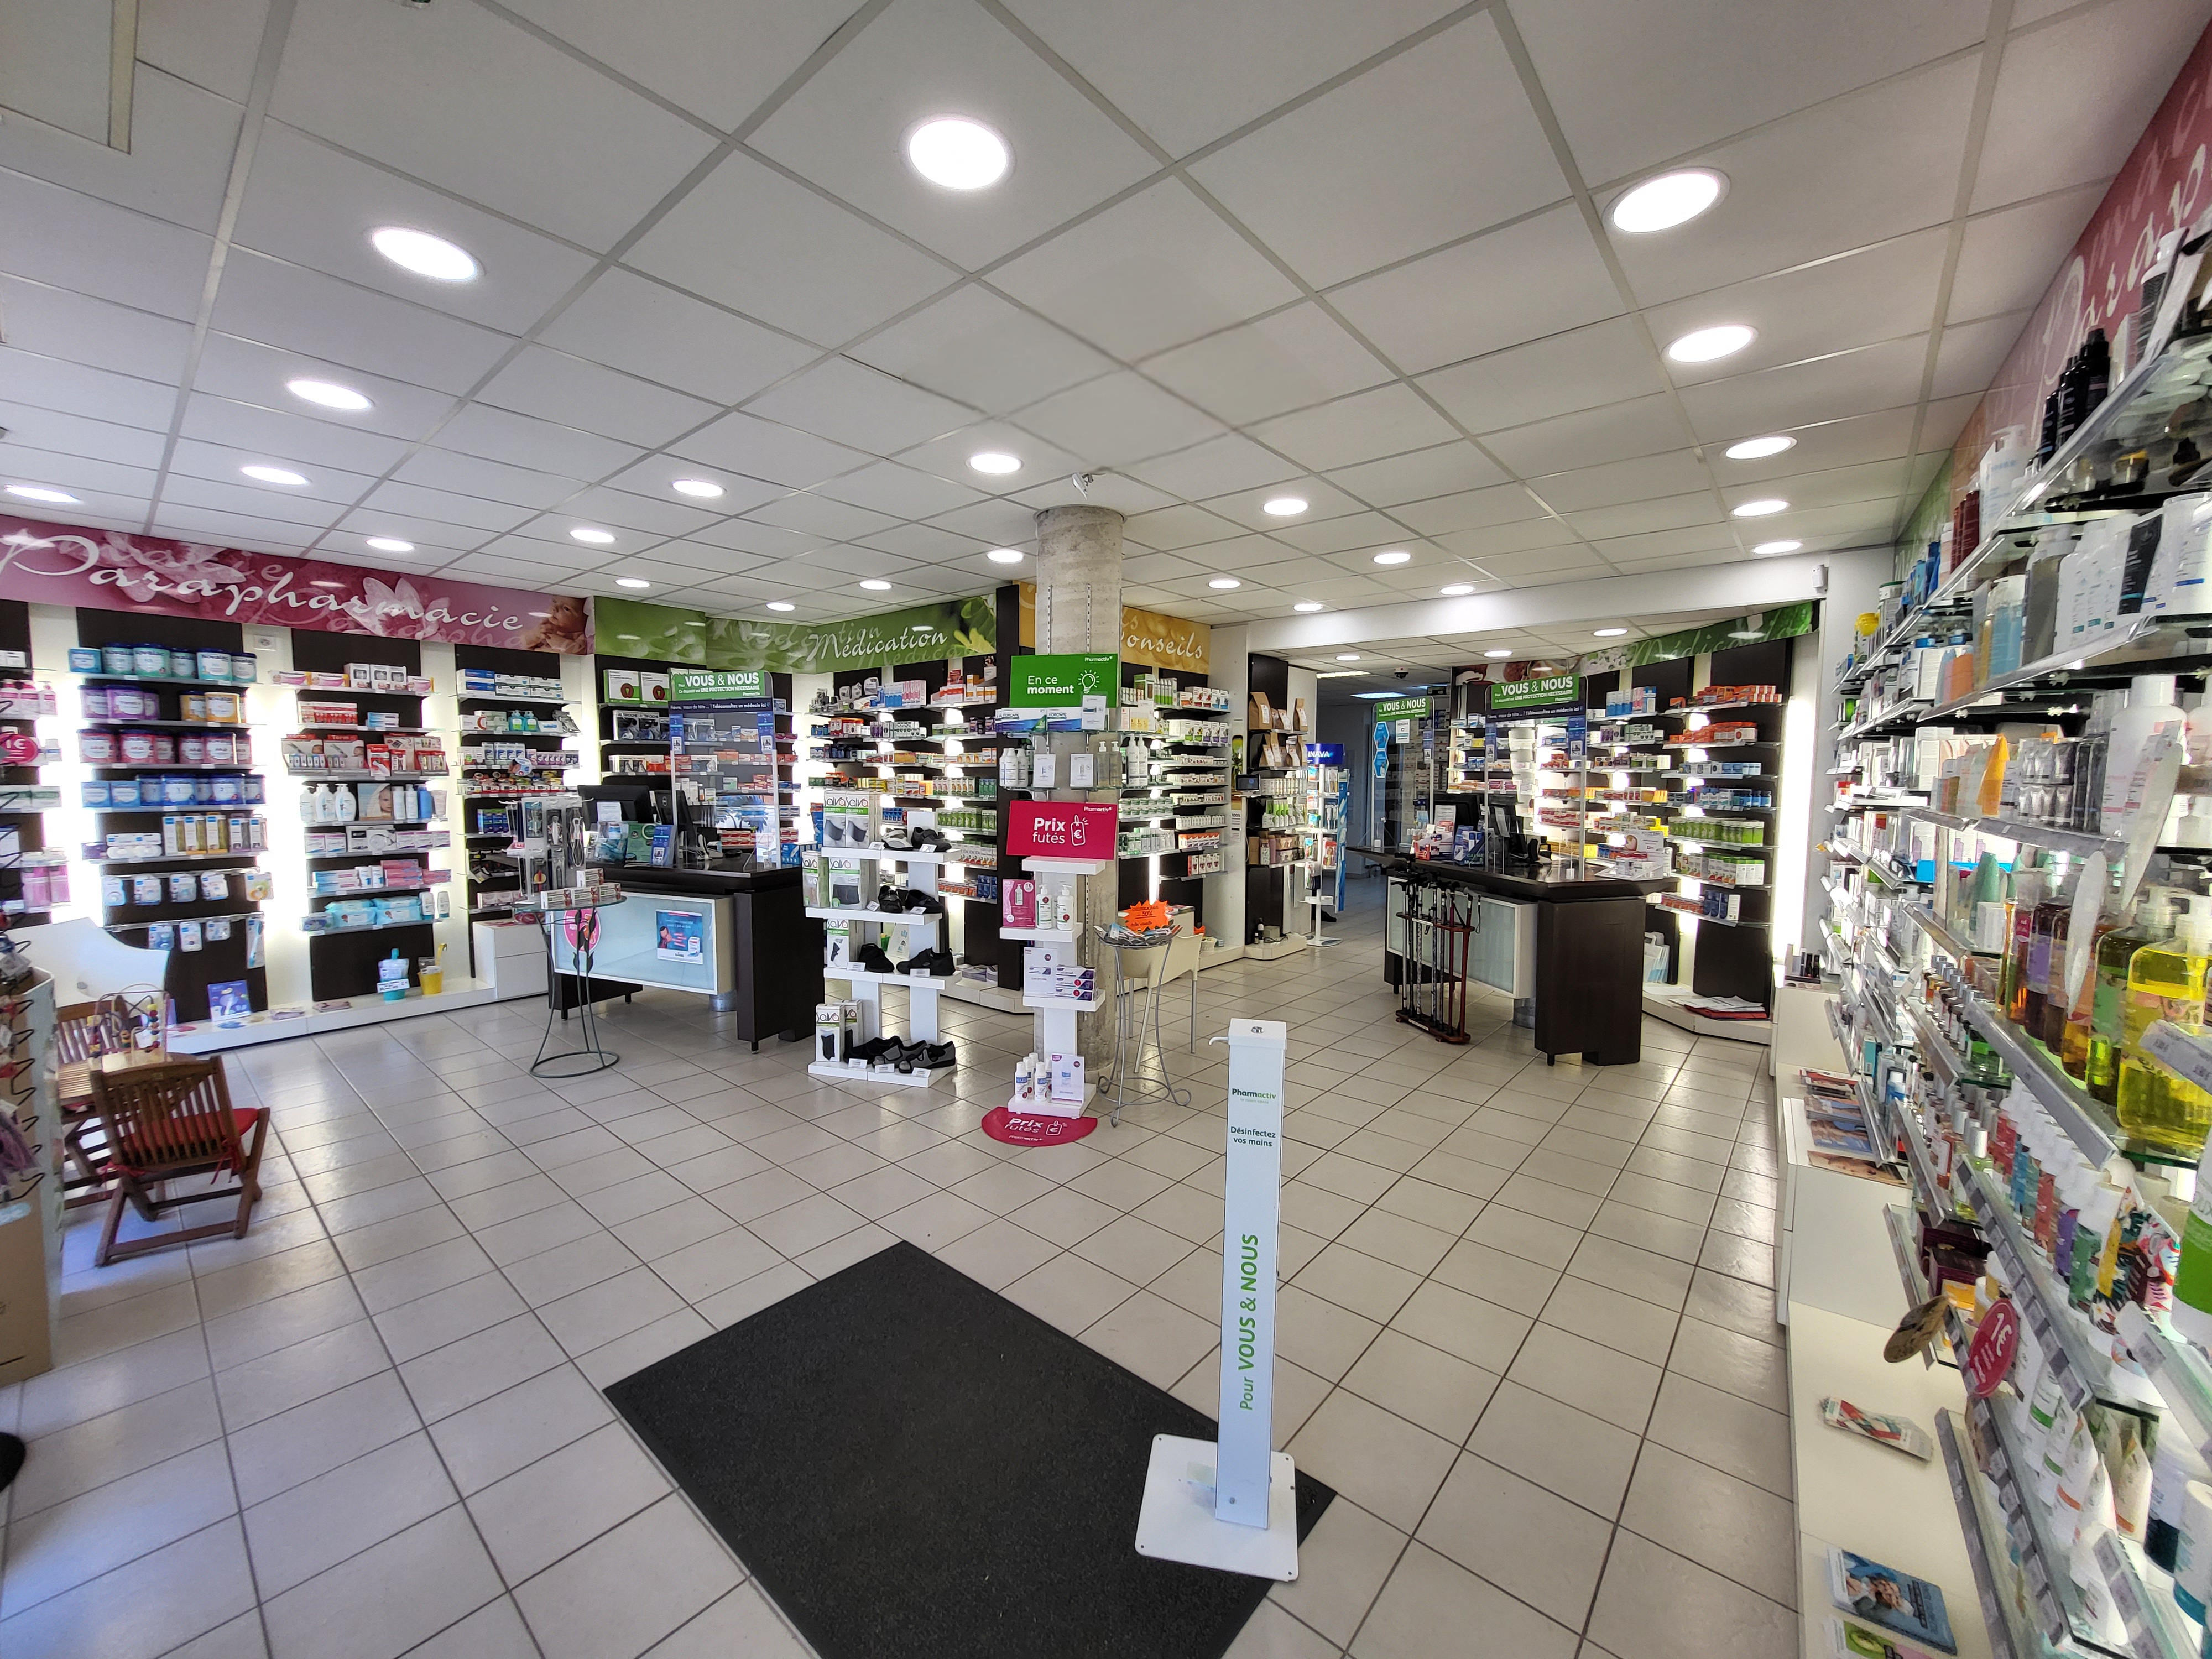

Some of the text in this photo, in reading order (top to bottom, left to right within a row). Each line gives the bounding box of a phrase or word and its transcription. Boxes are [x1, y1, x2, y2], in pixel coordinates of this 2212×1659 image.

[0, 534, 523, 631] Parapharmacie
[806, 626, 948, 662] Médication
[1121, 632, 1203, 660] onseils
[685, 675, 715, 687] VOUS
[717, 674, 725, 686] &
[727, 672, 759, 685] NOUS
[1027, 675, 1058, 685] En ce
[1501, 682, 1529, 696] VOUS
[1531, 681, 1538, 692] &
[1541, 676, 1573, 691] NOUS
[1027, 685, 1074, 695] moment
[1383, 701, 1400, 712] VOUS
[1401, 701, 1406, 710] &
[1406, 698, 1426, 709] NOUS
[1034, 817, 1066, 832] Prix
[1032, 831, 1065, 844] futés
[844, 1009, 857, 1018] lva
[1232, 1088, 1277, 1100] Pharmactiv
[1004, 1123, 1039, 1133] futés
[1009, 1118, 1044, 1128] Prix
[1230, 1126, 1276, 1139] Désinfectez
[1233, 1136, 1272, 1147] vos mains
[1238, 1233, 1259, 1411] Pour VOUS & NOUS
